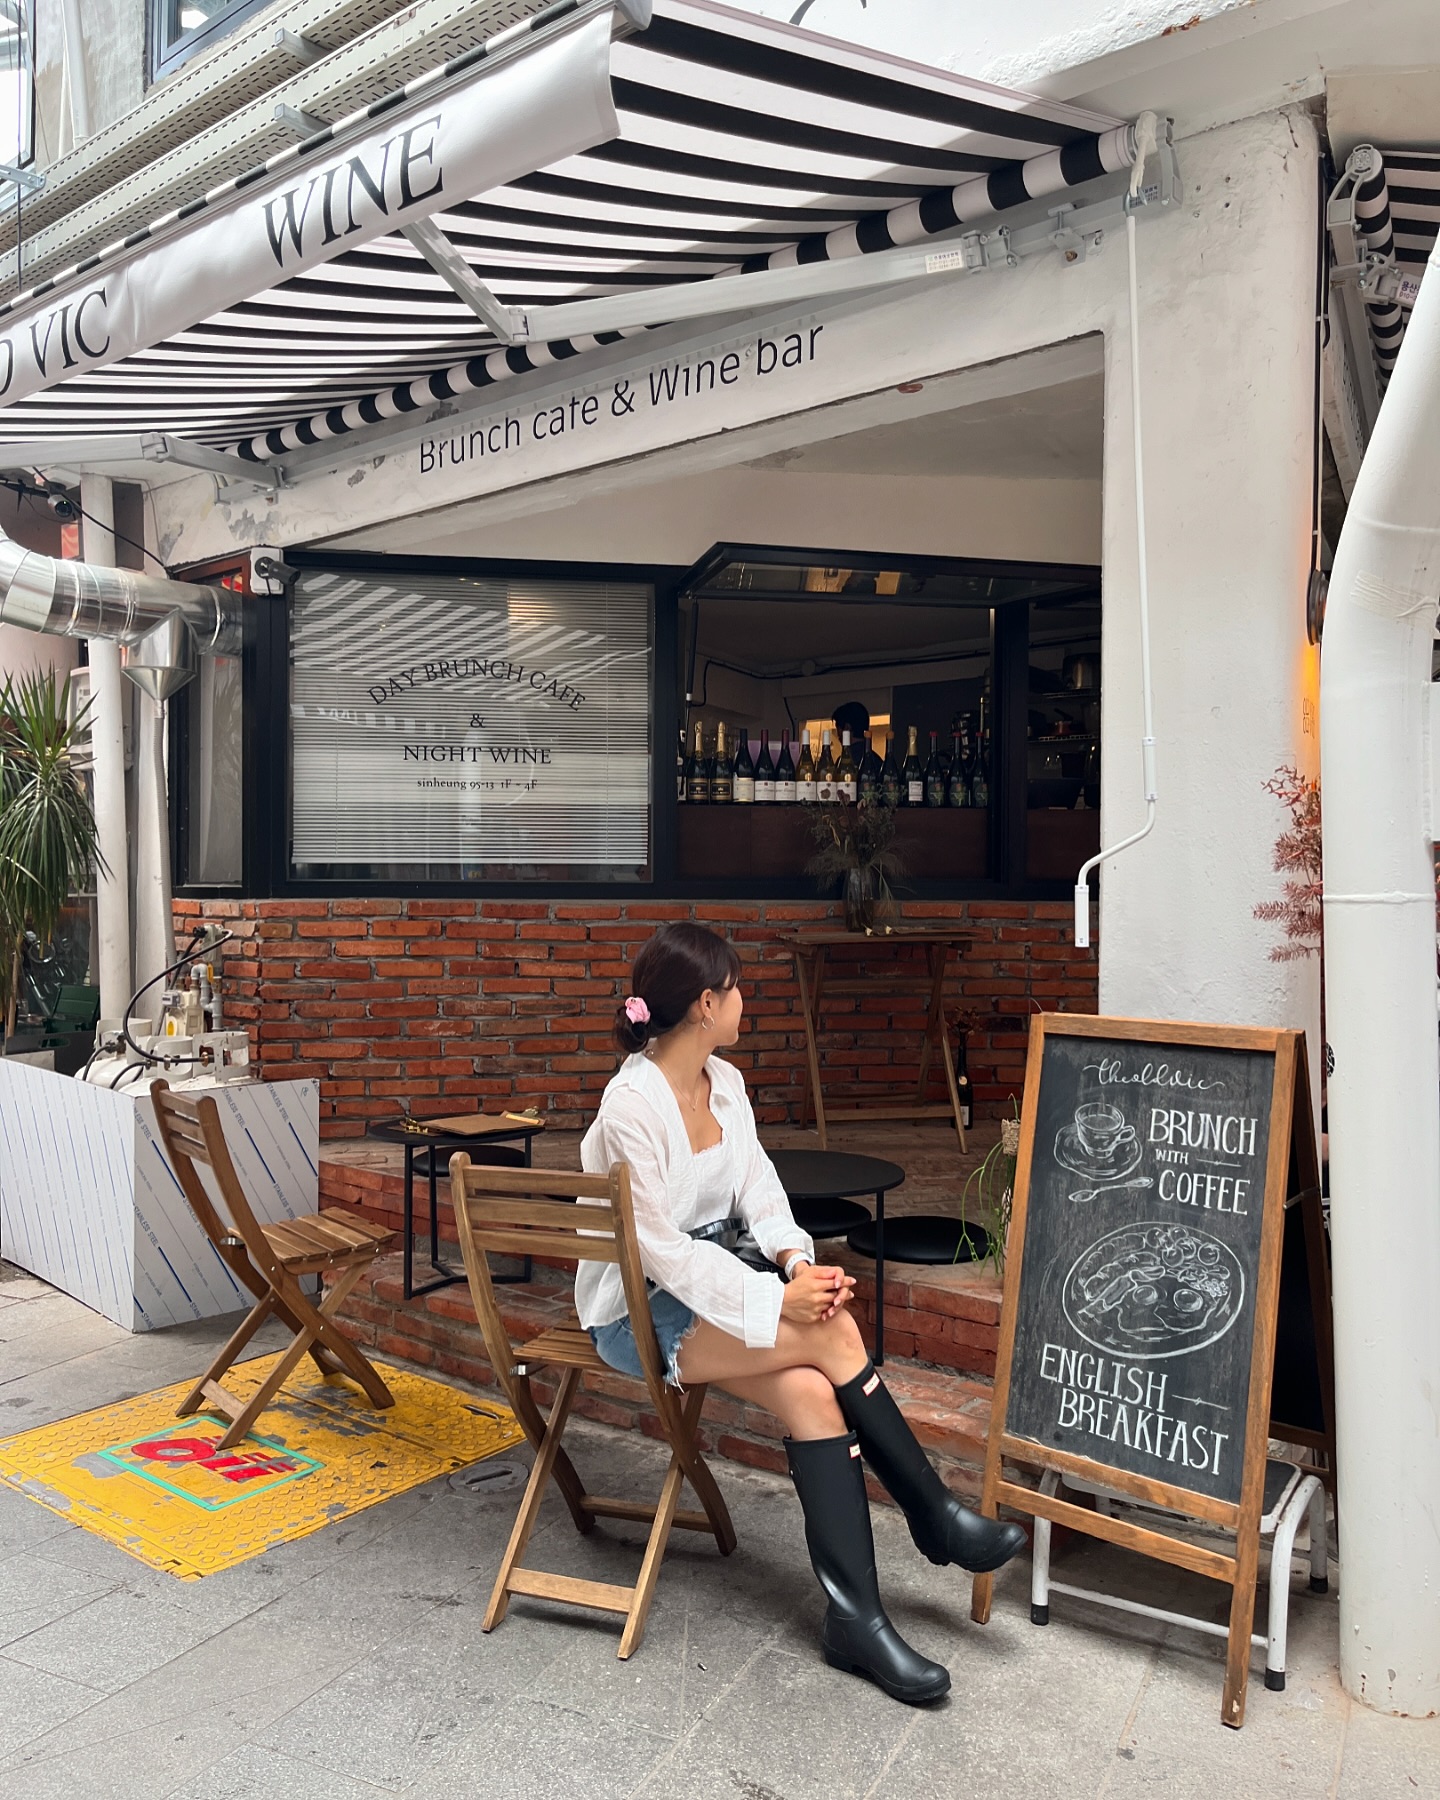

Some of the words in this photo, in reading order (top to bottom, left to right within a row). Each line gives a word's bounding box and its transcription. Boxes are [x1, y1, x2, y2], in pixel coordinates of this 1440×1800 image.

[262, 113, 444, 269] WINE
[29, 287, 111, 378] VIC
[420, 416, 520, 474] Brunch
[611, 380, 636, 417] &
[648, 350, 740, 406] Wine
[756, 324, 824, 376] bar
[366, 667, 417, 705] DAY
[422, 658, 525, 683] BRUNCH
[529, 671, 587, 712] CAFE
[469, 713, 486, 729] &
[402, 744, 483, 763] NIGHT
[488, 748, 552, 765] WINE
[417, 776, 467, 791] sinheung
[469, 780, 495, 791] 95-13
[524, 778, 538, 791] 4F
[1148, 1107, 1259, 1156] BRUNCH
[1154, 1148, 1190, 1166] WITH
[1158, 1169, 1251, 1216] COFFEE
[1039, 1342, 1168, 1413] ENGLISH
[1057, 1387, 1229, 1476] BREAKFAST
